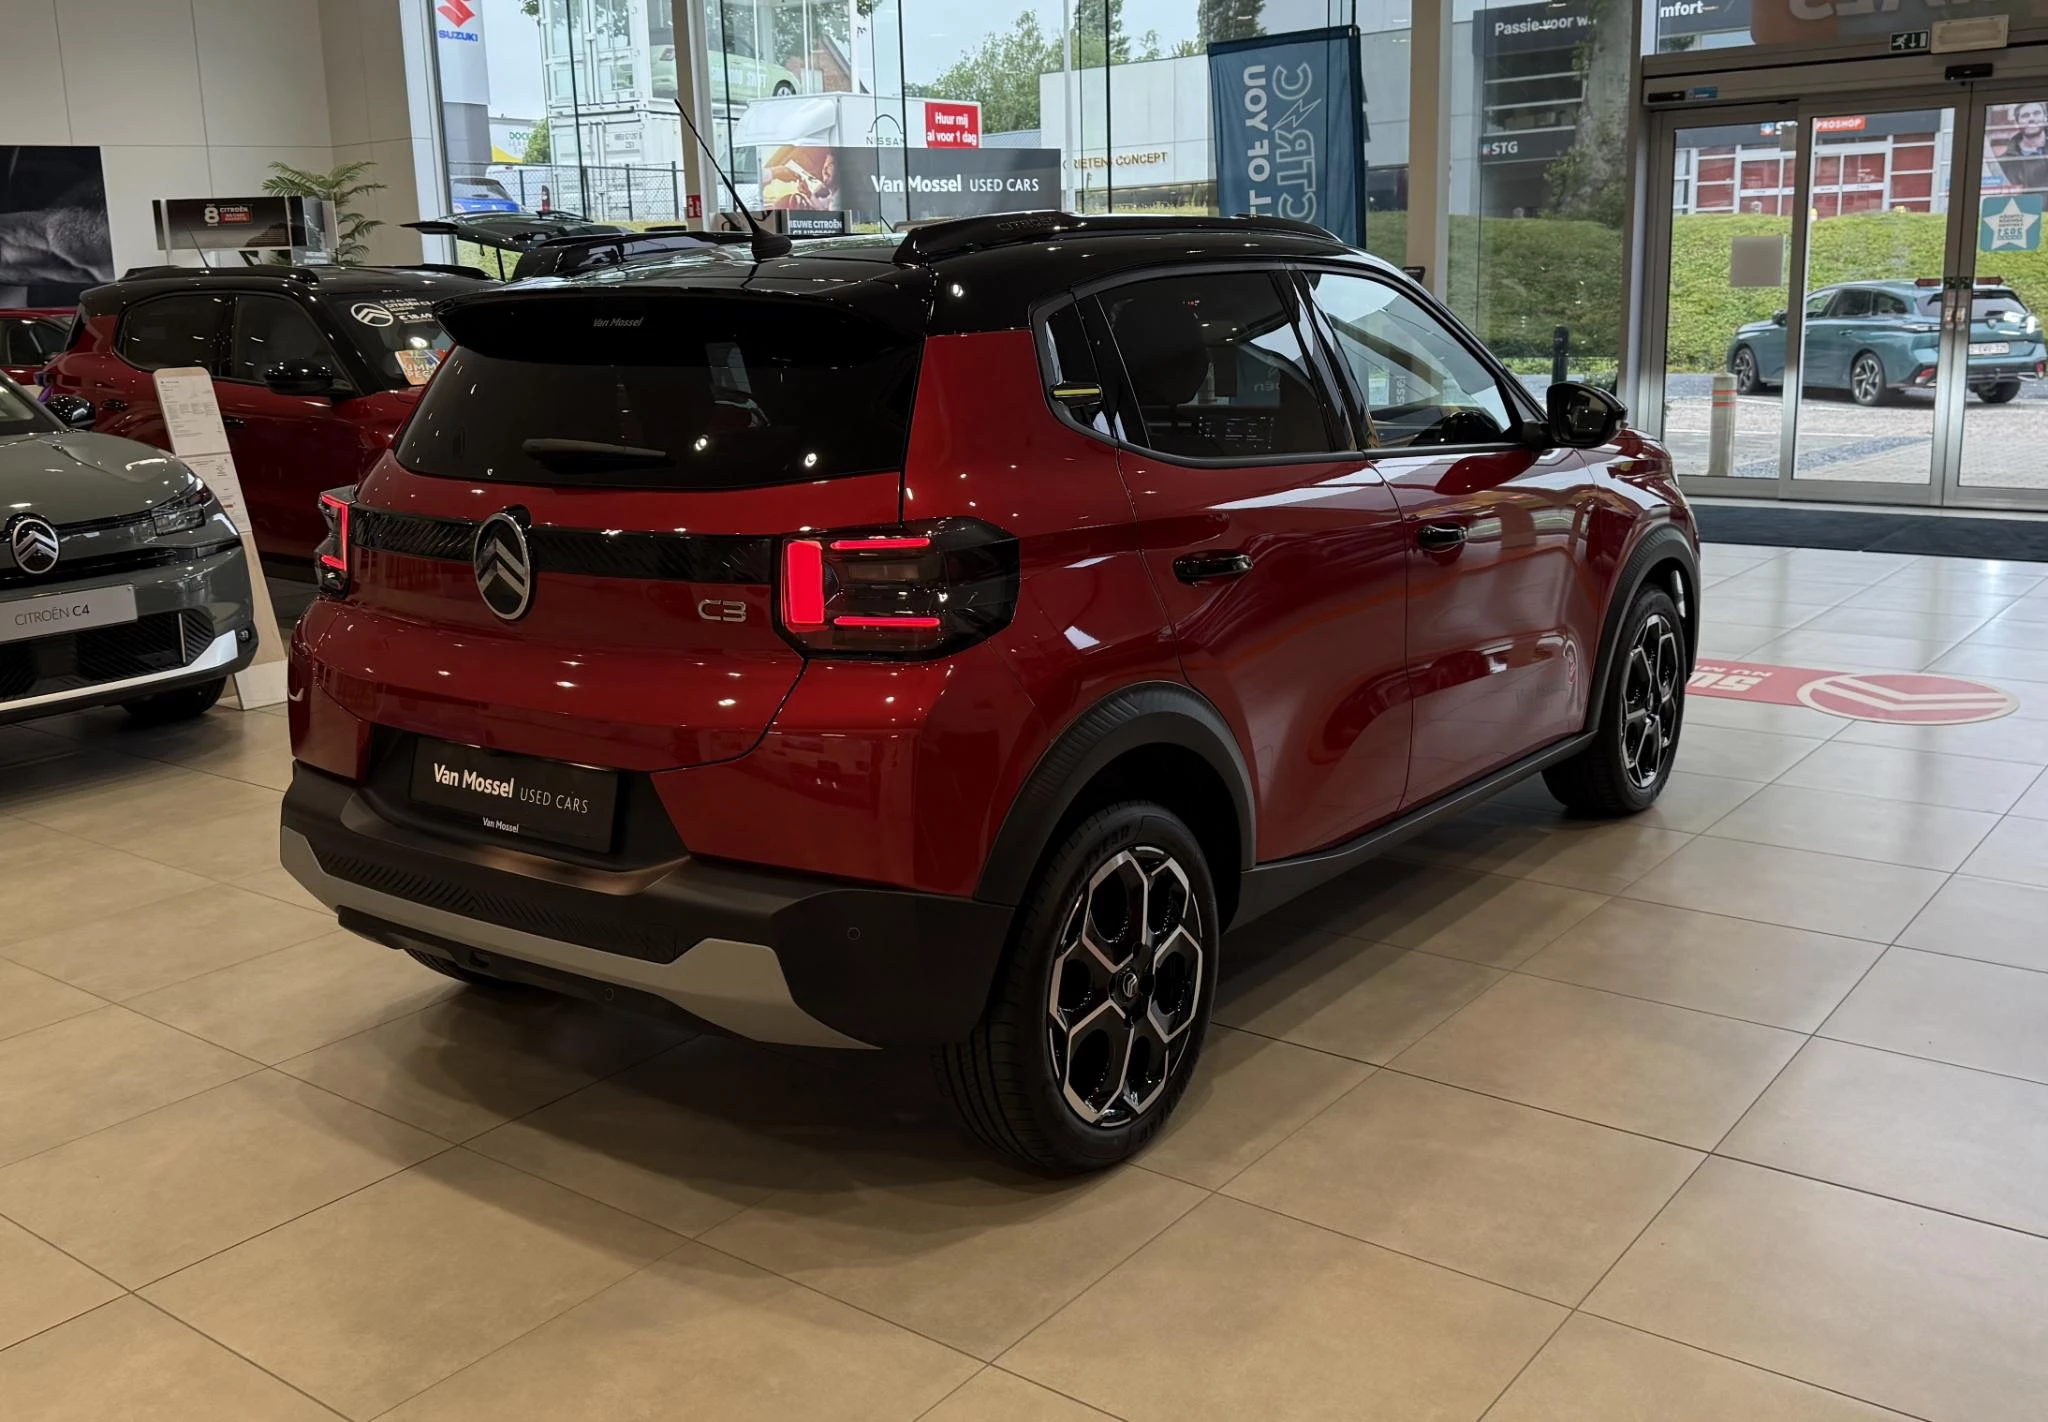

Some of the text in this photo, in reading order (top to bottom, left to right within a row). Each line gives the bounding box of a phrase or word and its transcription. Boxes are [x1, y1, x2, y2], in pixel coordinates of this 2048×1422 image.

[1660, 0, 1703, 18] mfort
[1494, 17, 1540, 36] Passie
[1542, 16, 1574, 30] voor
[438, 29, 478, 42] SUZUKI
[935, 111, 969, 127] Huur mij
[1816, 118, 1862, 129] PROSHOP
[926, 131, 977, 146] al voor 1 dag
[1491, 141, 1518, 155] STG
[1116, 152, 1168, 166] CONCEPT
[871, 174, 1039, 192] Van Mossel USED CARS
[204, 207, 220, 224] 8
[790, 219, 813, 229] IEUWE
[593, 316, 644, 327] Van Mossel
[14, 604, 90, 626] CITROËN C4
[698, 599, 747, 622] C3
[433, 763, 589, 814] Van Mossel USED CARS
[482, 817, 519, 833] Van Mossel
